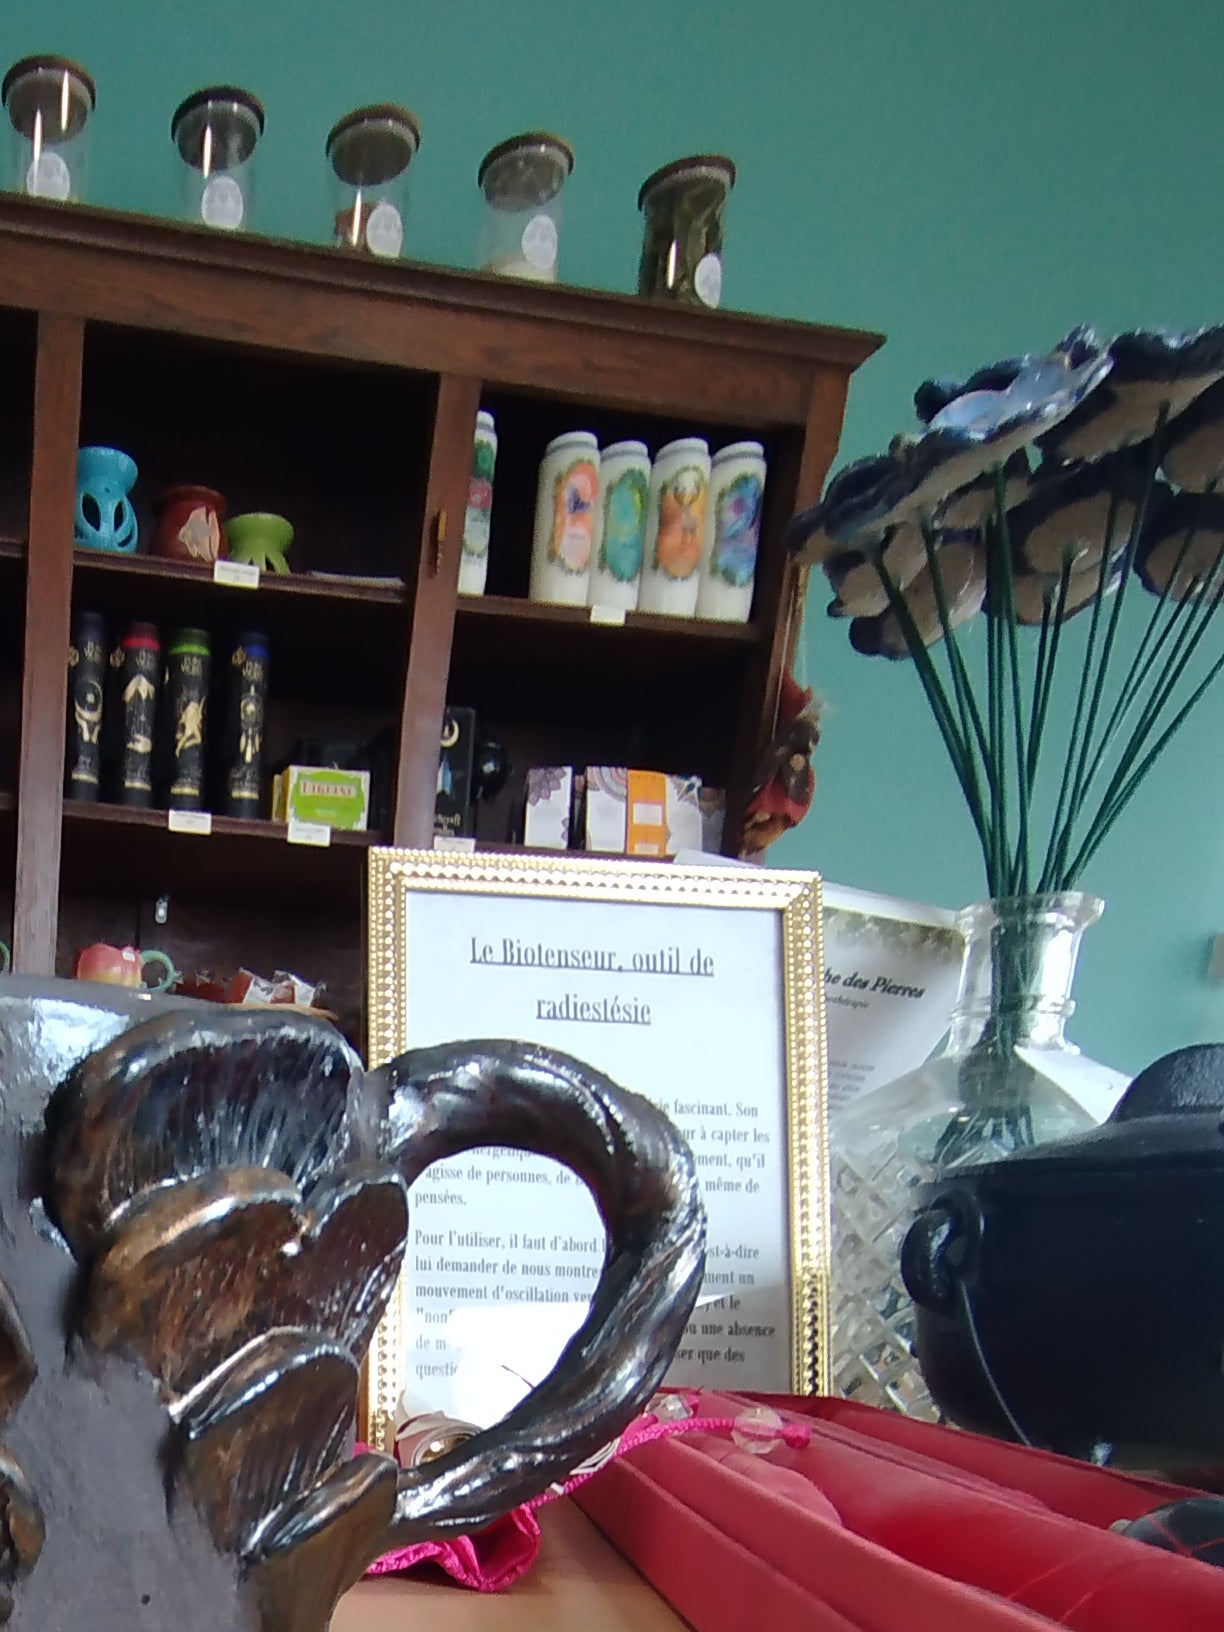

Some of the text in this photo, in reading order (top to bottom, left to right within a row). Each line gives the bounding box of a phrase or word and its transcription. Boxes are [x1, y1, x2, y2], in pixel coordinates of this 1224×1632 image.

[470, 936, 714, 977] Le Biotenseur, outil de
[842, 972, 870, 990] des
[870, 976, 925, 999] Pierres
[536, 994, 651, 1024] radiestésie
[674, 1099, 732, 1117] fascinant.
[736, 1102, 758, 1118] Son
[700, 1125, 707, 1140] à
[711, 1129, 749, 1146] capter
[753, 1128, 770, 1143] les
[736, 1153, 765, 1171] qu'il
[467, 1165, 482, 1180] de
[486, 1171, 552, 1186] personnes,
[556, 1170, 571, 1185] de
[705, 1177, 760, 1193] même de
[415, 1229, 444, 1246] Pour
[509, 1233, 518, 1249] il
[522, 1233, 546, 1250] faut
[550, 1235, 597, 1253] d'abord
[706, 1243, 759, 1259] st-à-dire
[415, 1255, 432, 1272] lui
[436, 1257, 498, 1274] demander
[502, 1259, 517, 1274] de
[521, 1263, 550, 1277] nous
[739, 1273, 755, 1285] un
[415, 1284, 487, 1300] mouvement
[492, 1284, 569, 1303] d'oscillation
[730, 1295, 741, 1310] le
[701, 1323, 723, 1335] une
[728, 1321, 775, 1337] absence
[416, 1334, 430, 1350] de
[698, 1349, 721, 1364] que
[724, 1347, 745, 1362] des
